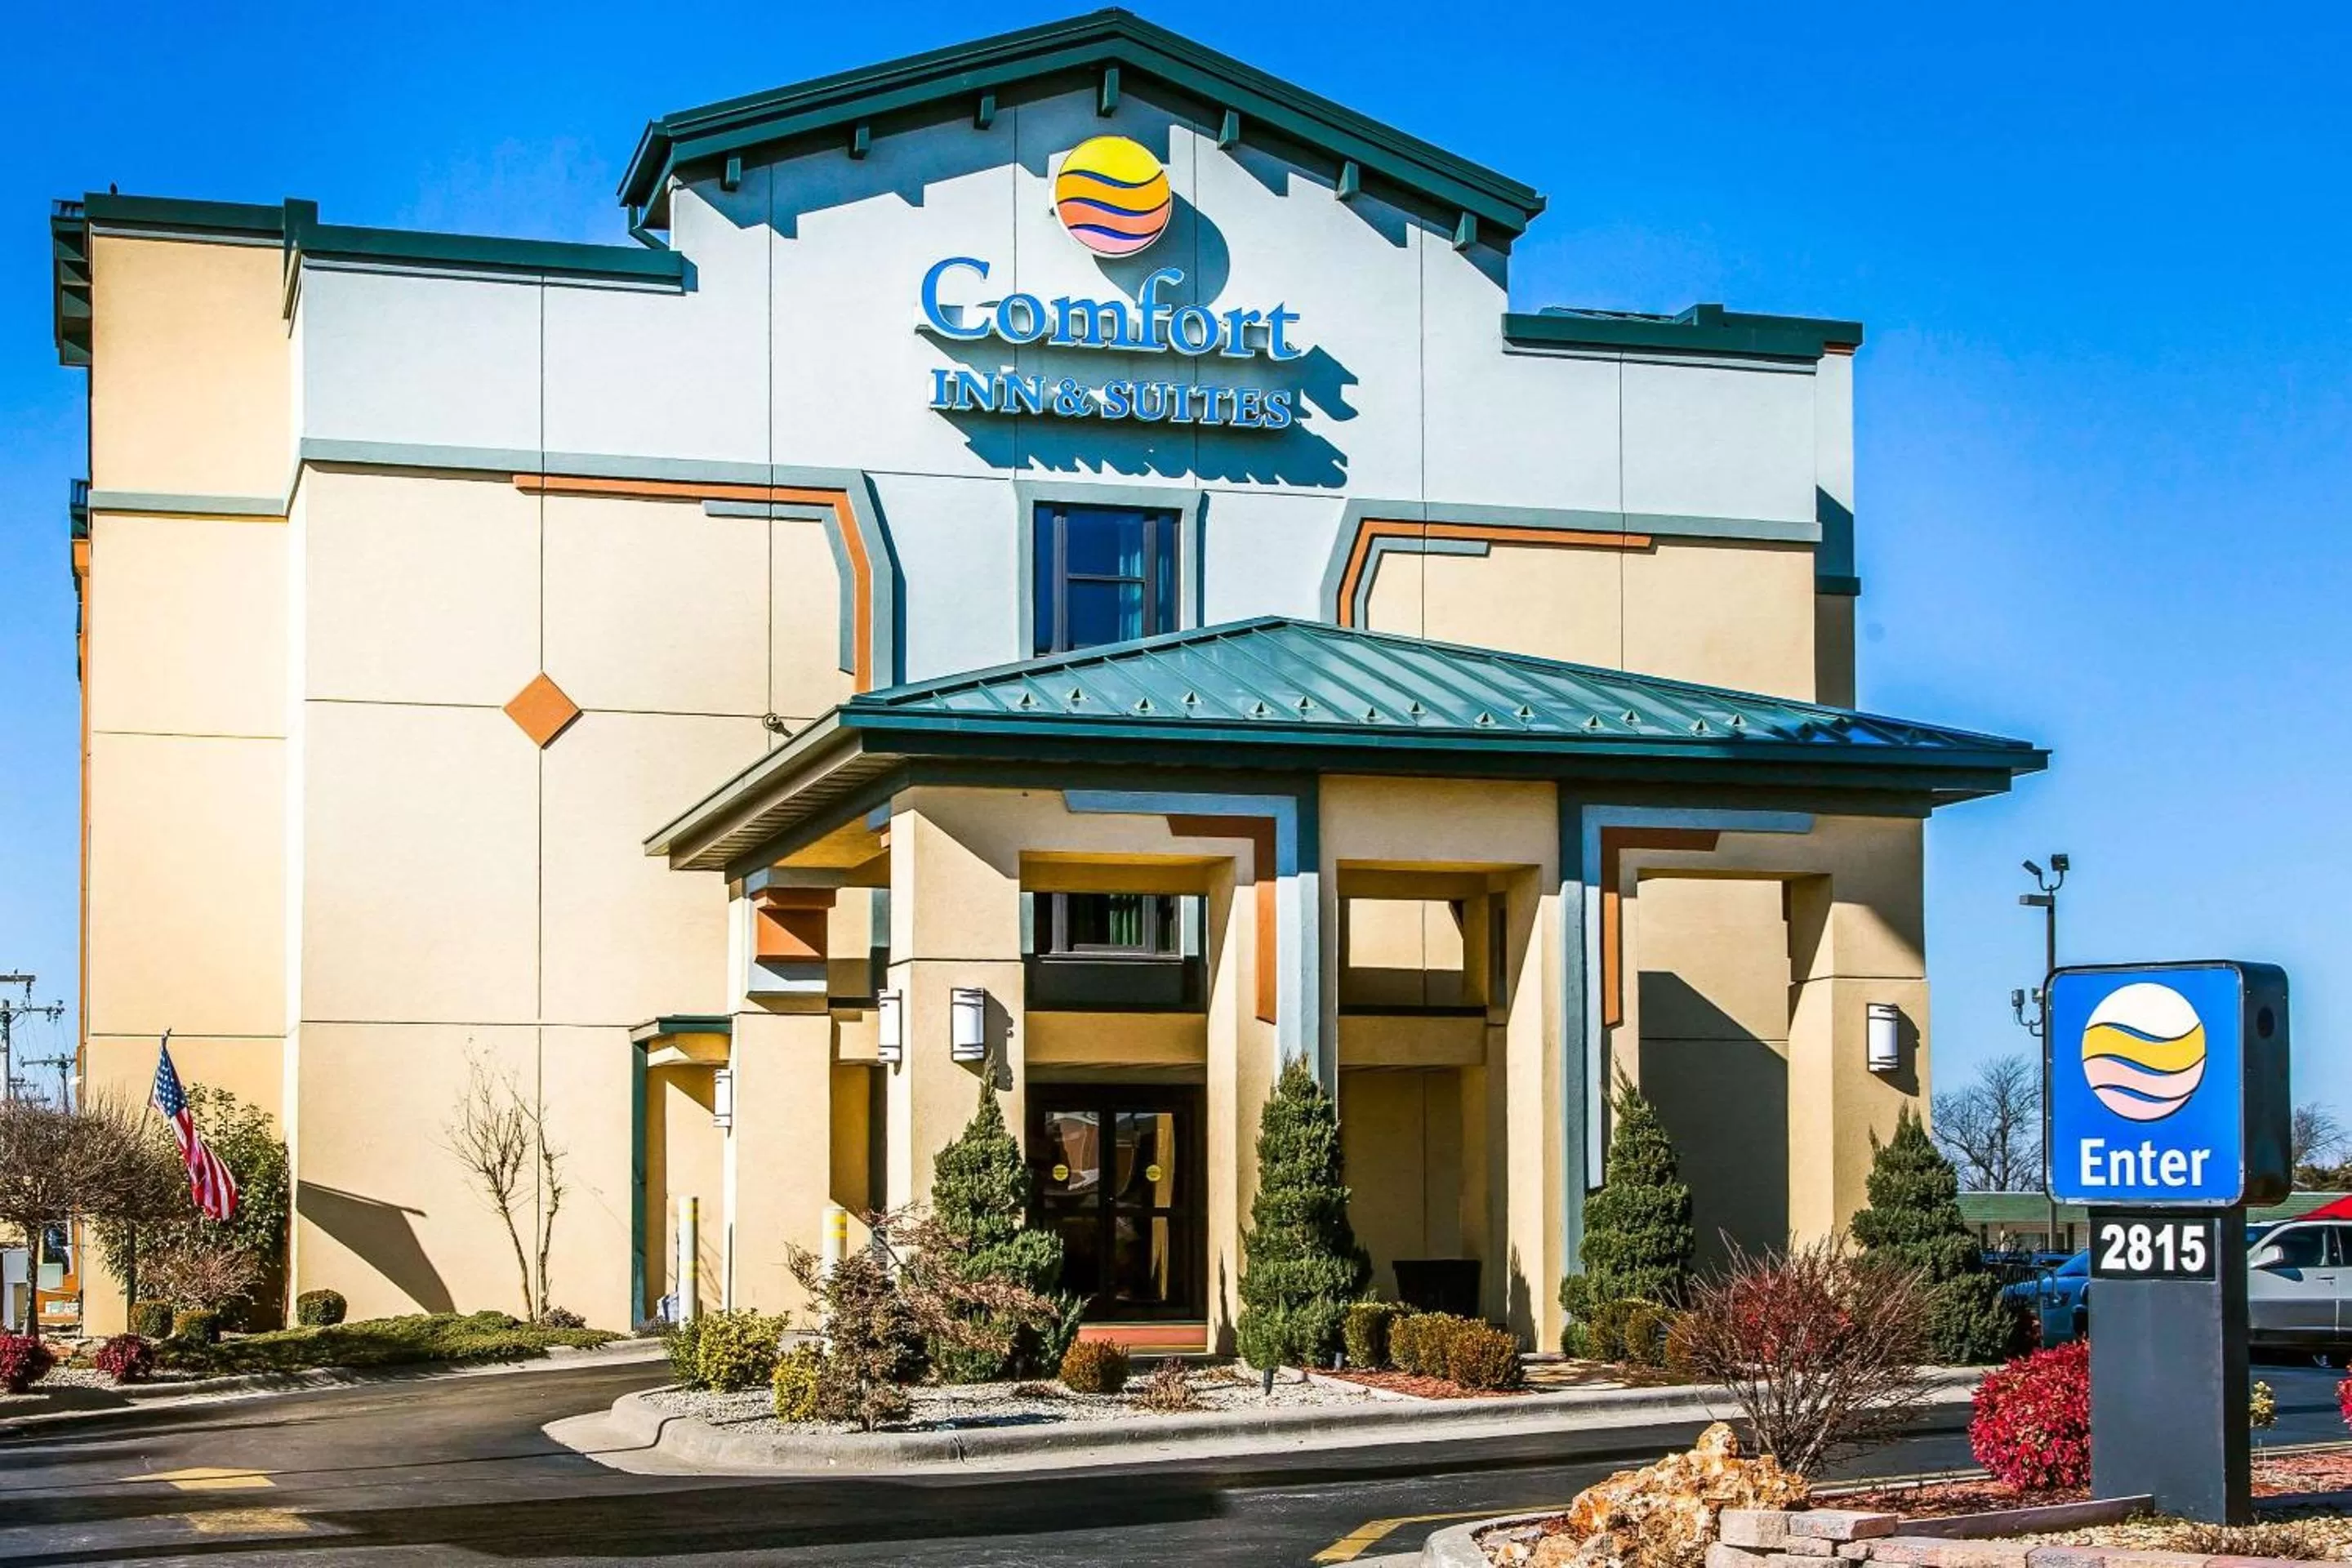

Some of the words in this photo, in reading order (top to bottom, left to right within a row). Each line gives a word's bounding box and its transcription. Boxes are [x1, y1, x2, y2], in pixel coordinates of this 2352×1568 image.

[921, 256, 1302, 360] Comfort
[930, 369, 1045, 414] INN
[1054, 376, 1093, 417] &
[1101, 381, 1293, 428] SUITES
[2080, 1138, 2211, 1187] Enter
[2100, 1223, 2207, 1272] 2815
